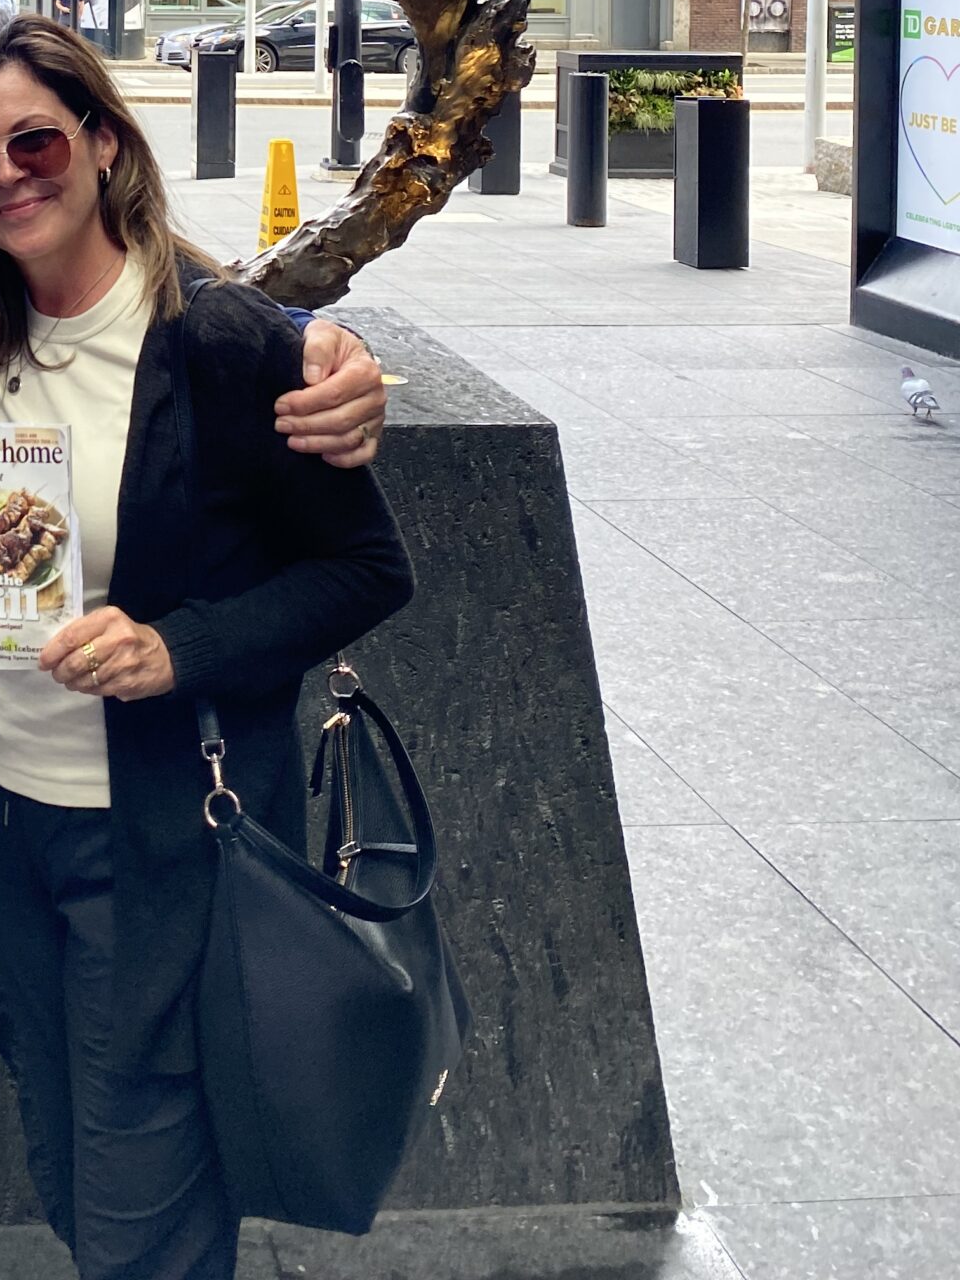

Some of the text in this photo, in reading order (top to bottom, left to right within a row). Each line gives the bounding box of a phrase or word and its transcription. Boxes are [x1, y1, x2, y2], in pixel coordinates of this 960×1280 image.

[905, 15, 920, 33] TD
[909, 111, 957, 134] JUST BE
[274, 208, 295, 217] CAUTION
[14, 644, 43, 653] Iceber
